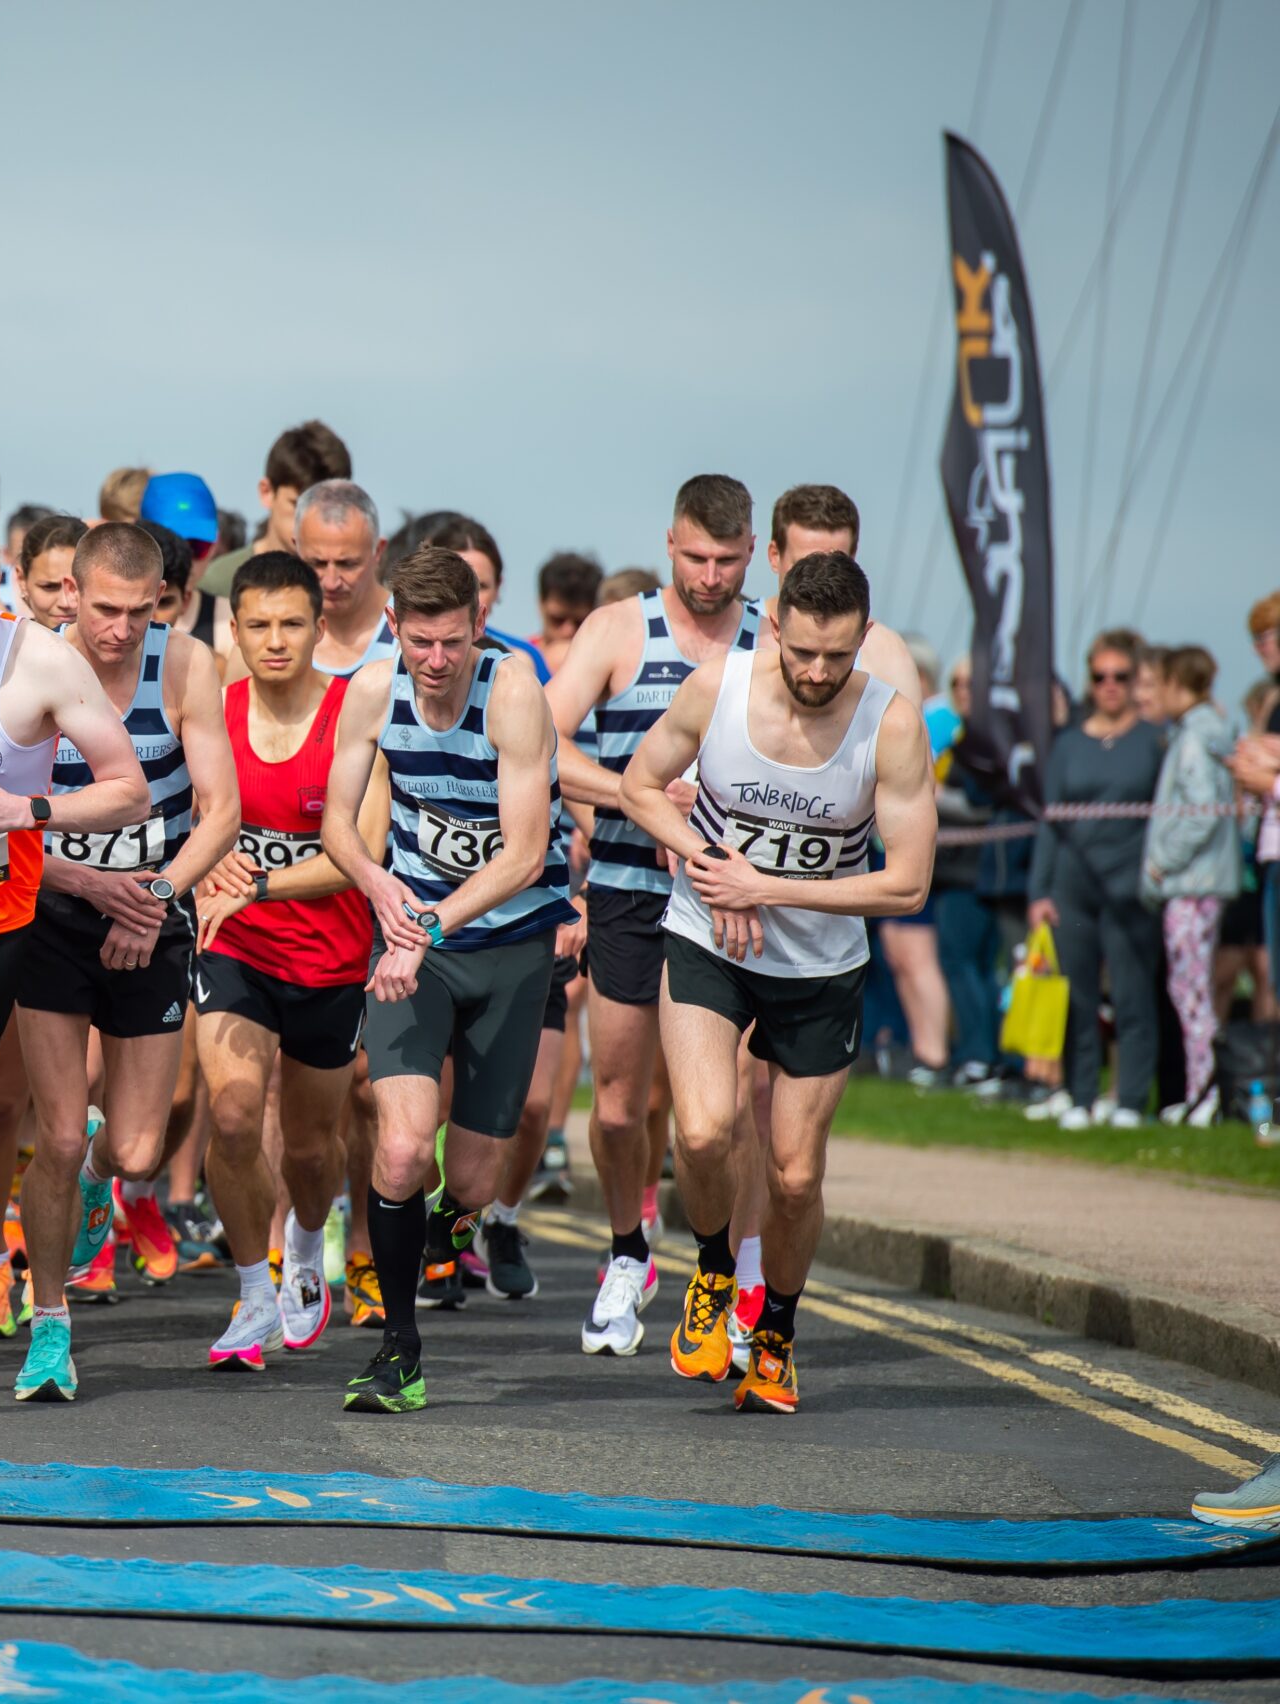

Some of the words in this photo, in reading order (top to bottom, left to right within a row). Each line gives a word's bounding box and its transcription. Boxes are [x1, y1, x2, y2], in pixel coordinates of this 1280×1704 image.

[731, 782, 836, 820] TONBRIDGE
[261, 829, 287, 841] WAVE
[289, 833, 294, 841] 1
[427, 815, 504, 868] 736
[448, 816, 473, 830] WAVE
[768, 819, 796, 832] WAVE
[60, 824, 149, 865] 871
[735, 822, 831, 869] 719
